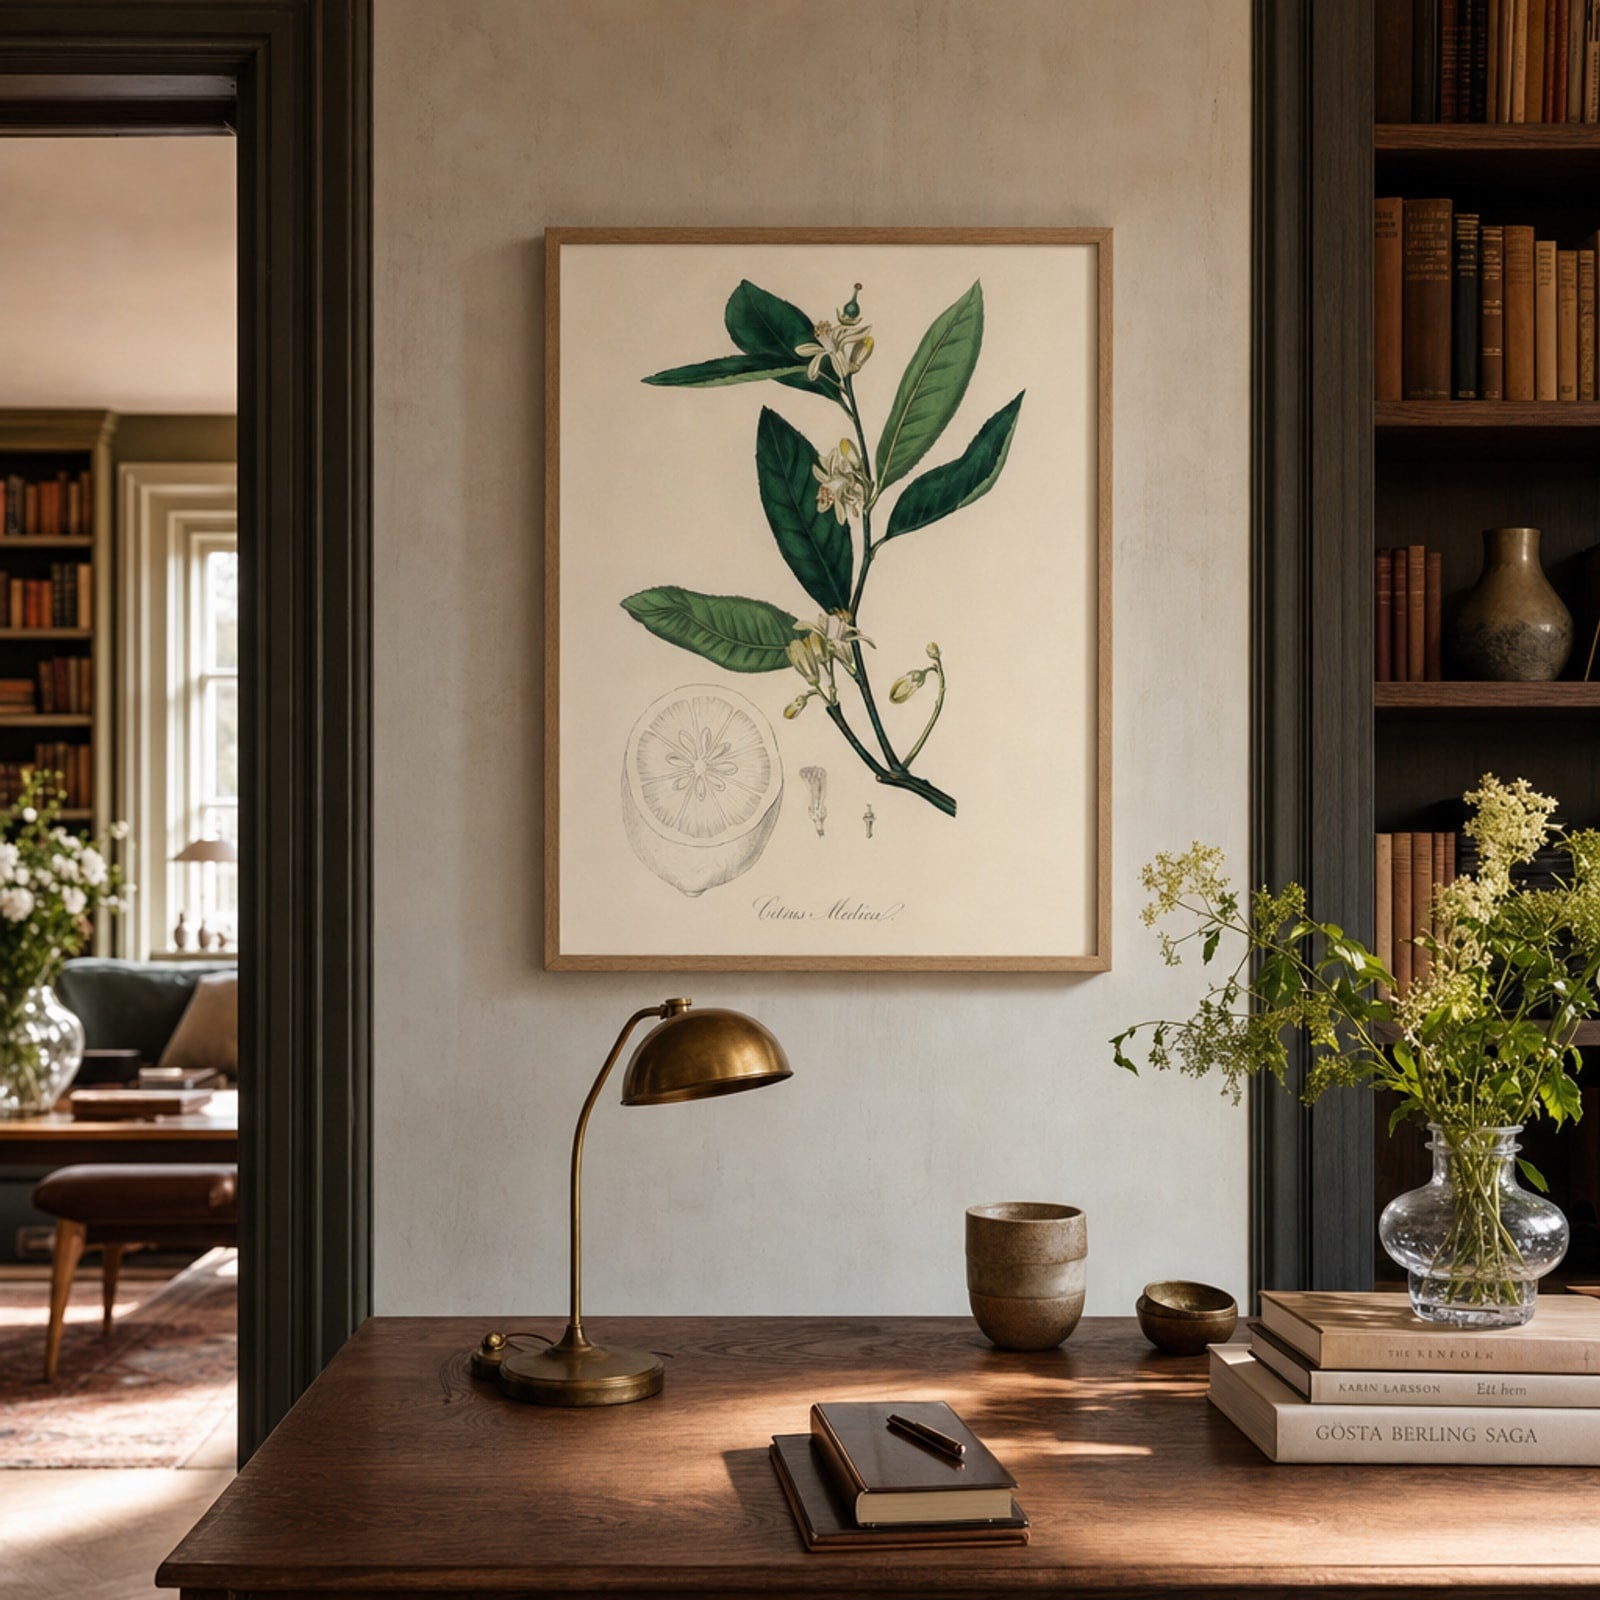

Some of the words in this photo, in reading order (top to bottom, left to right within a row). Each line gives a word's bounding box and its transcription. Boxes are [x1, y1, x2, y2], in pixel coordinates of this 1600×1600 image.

[1338, 1383, 1379, 1393] KARIN
[1383, 1383, 1441, 1394] LARSSON
[1476, 1382, 1496, 1396] Ett
[1501, 1382, 1528, 1396] hem
[1315, 1421, 1383, 1442] GÖSTA
[1391, 1425, 1477, 1443] BERLING
[1485, 1426, 1539, 1444] SAGA
